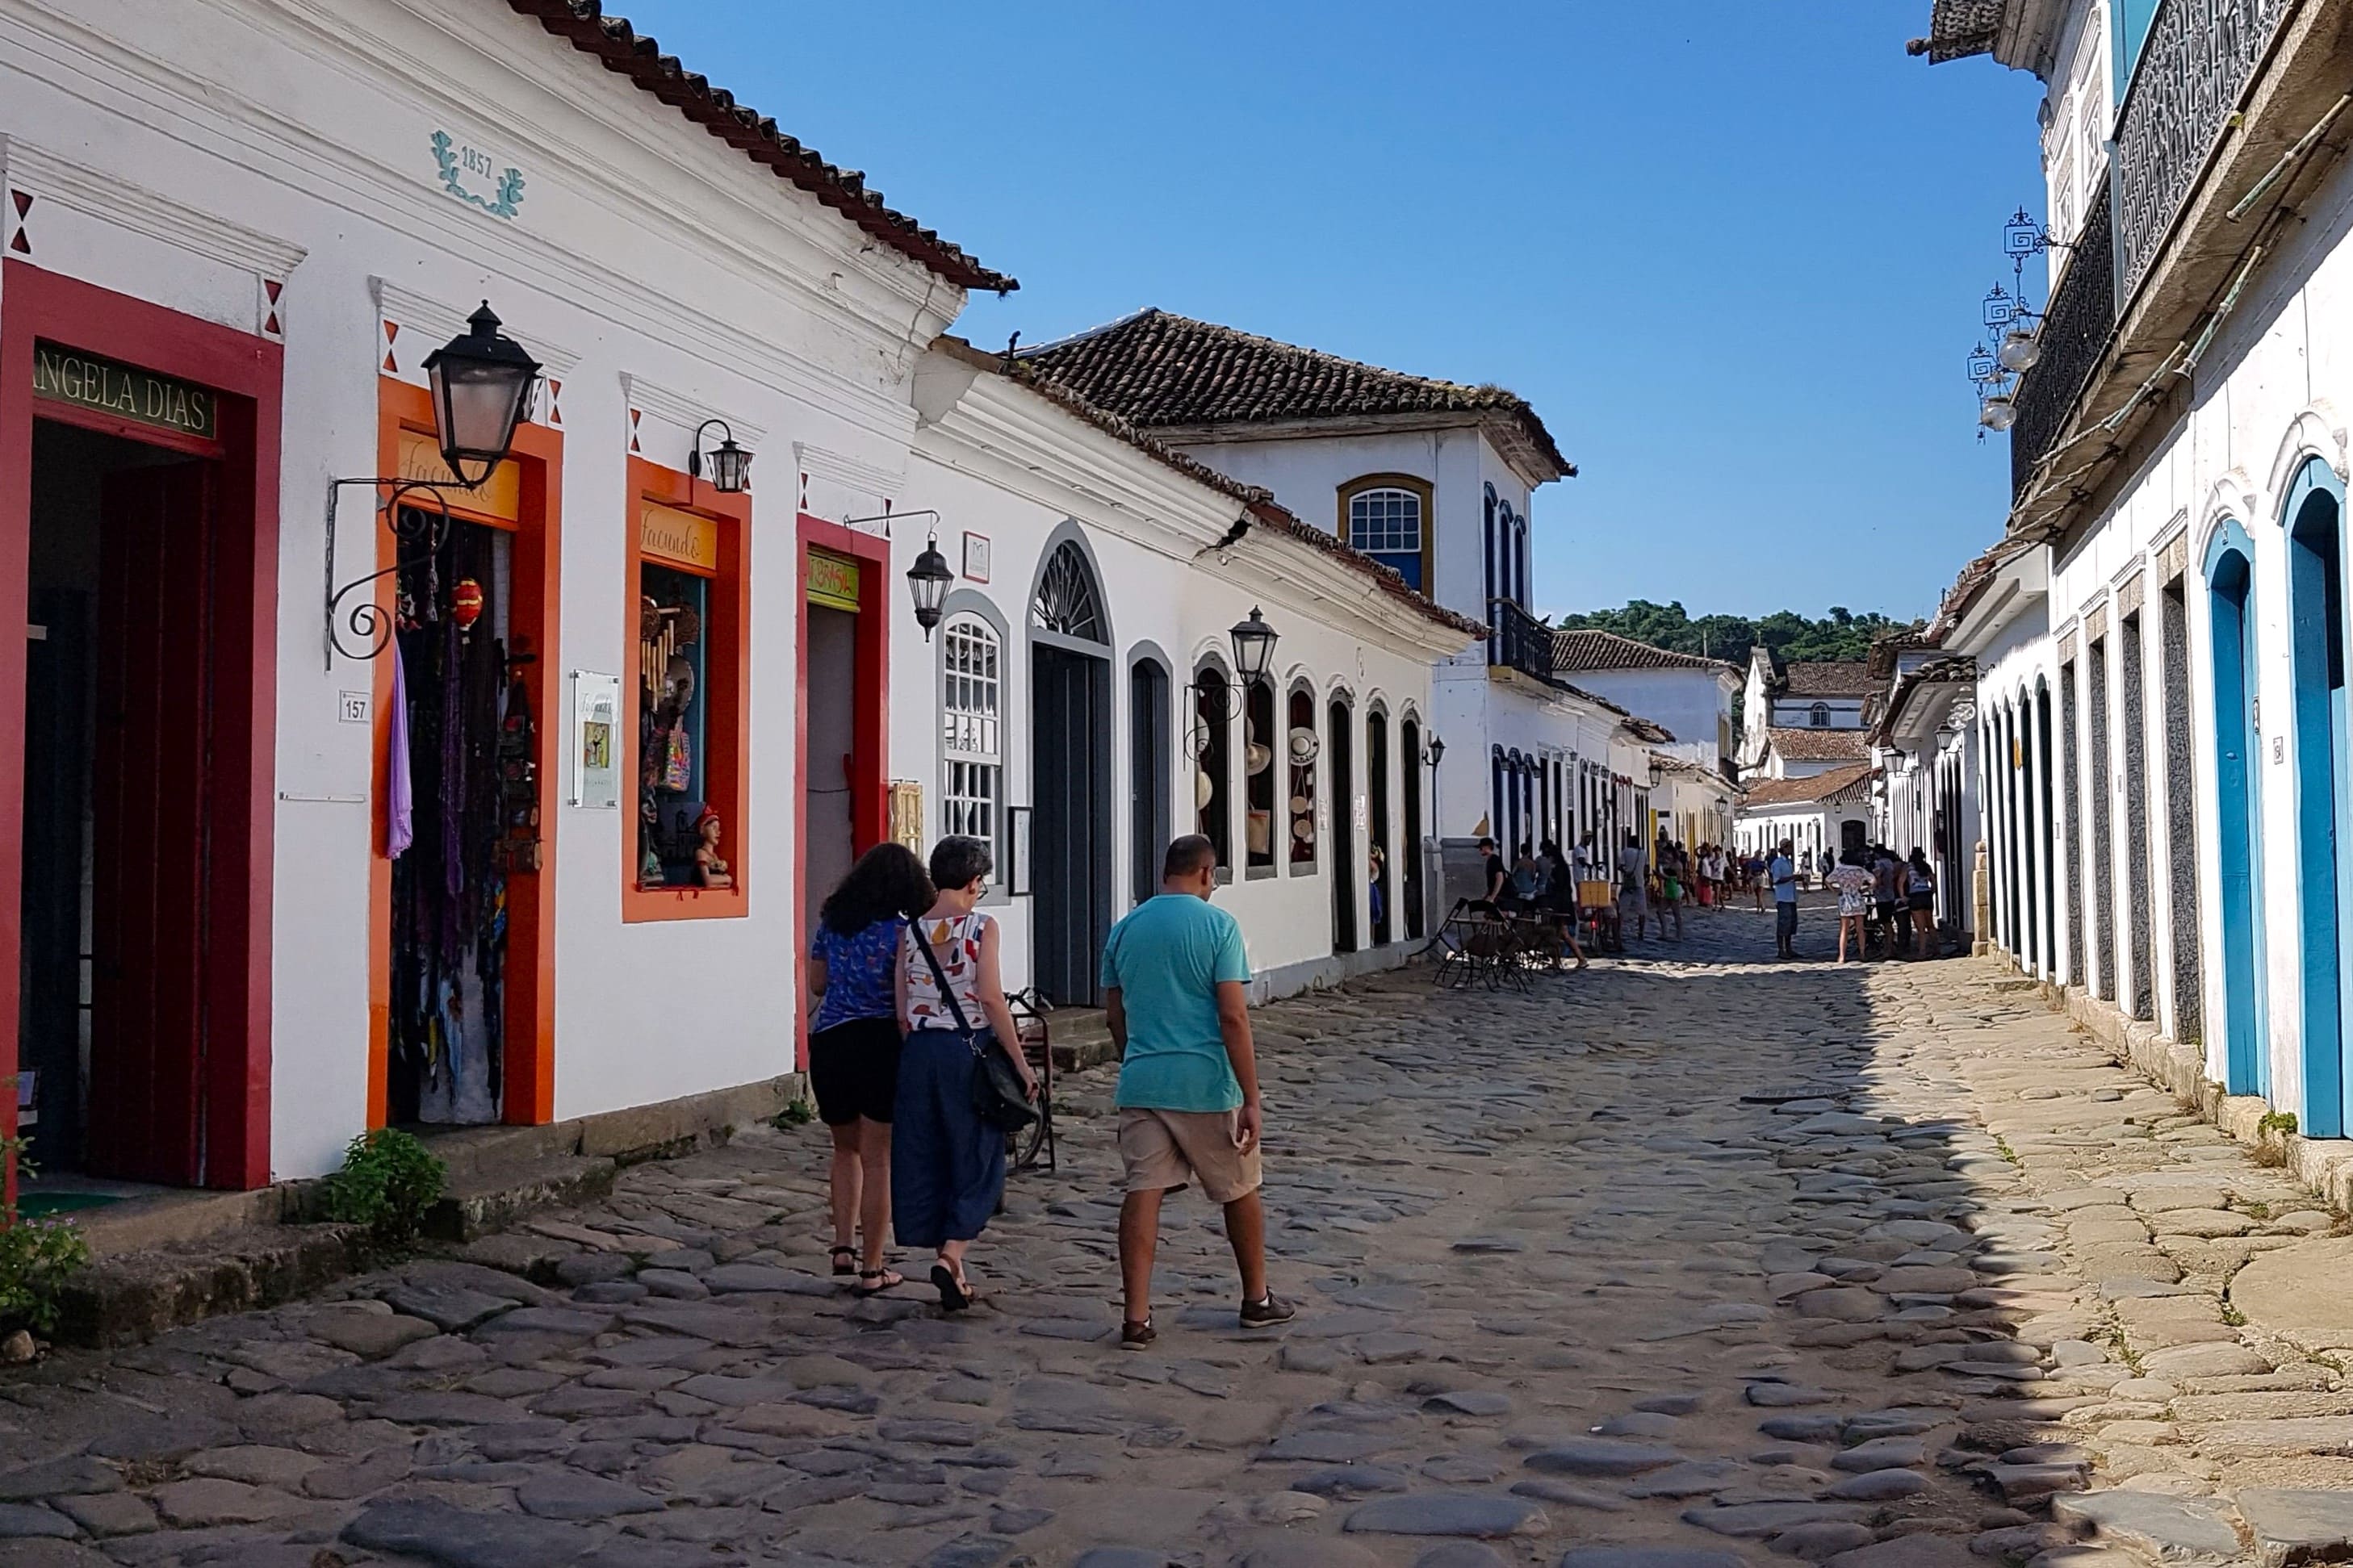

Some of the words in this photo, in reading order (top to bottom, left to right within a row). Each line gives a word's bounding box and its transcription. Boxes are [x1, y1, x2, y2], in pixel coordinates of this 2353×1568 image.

[462, 146, 492, 179] 1857
[33, 350, 136, 413] NGELA
[145, 378, 205, 430] DIAS
[346, 700, 366, 718] 157
